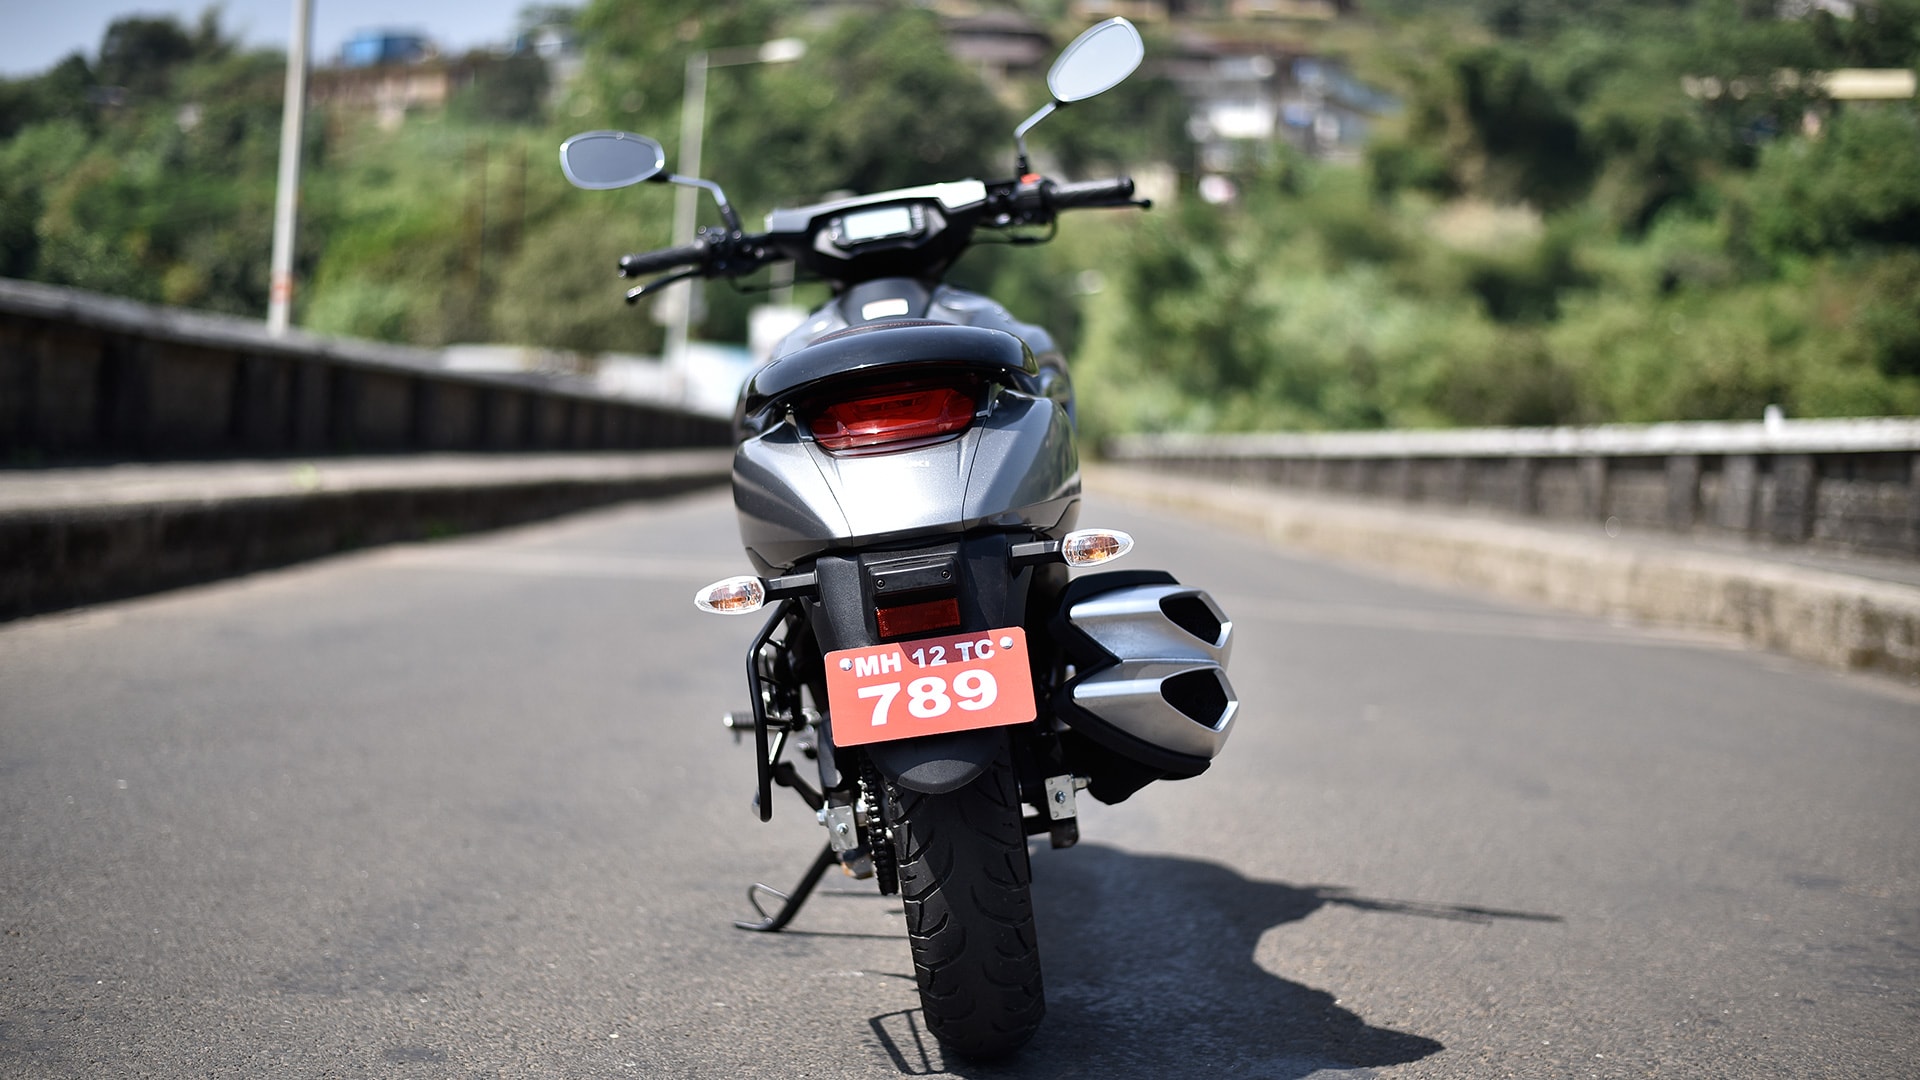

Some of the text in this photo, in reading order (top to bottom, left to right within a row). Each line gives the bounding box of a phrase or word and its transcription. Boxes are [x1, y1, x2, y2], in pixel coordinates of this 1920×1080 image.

[855, 638, 996, 678] MH 12 TC
[857, 669, 998, 727] 789
